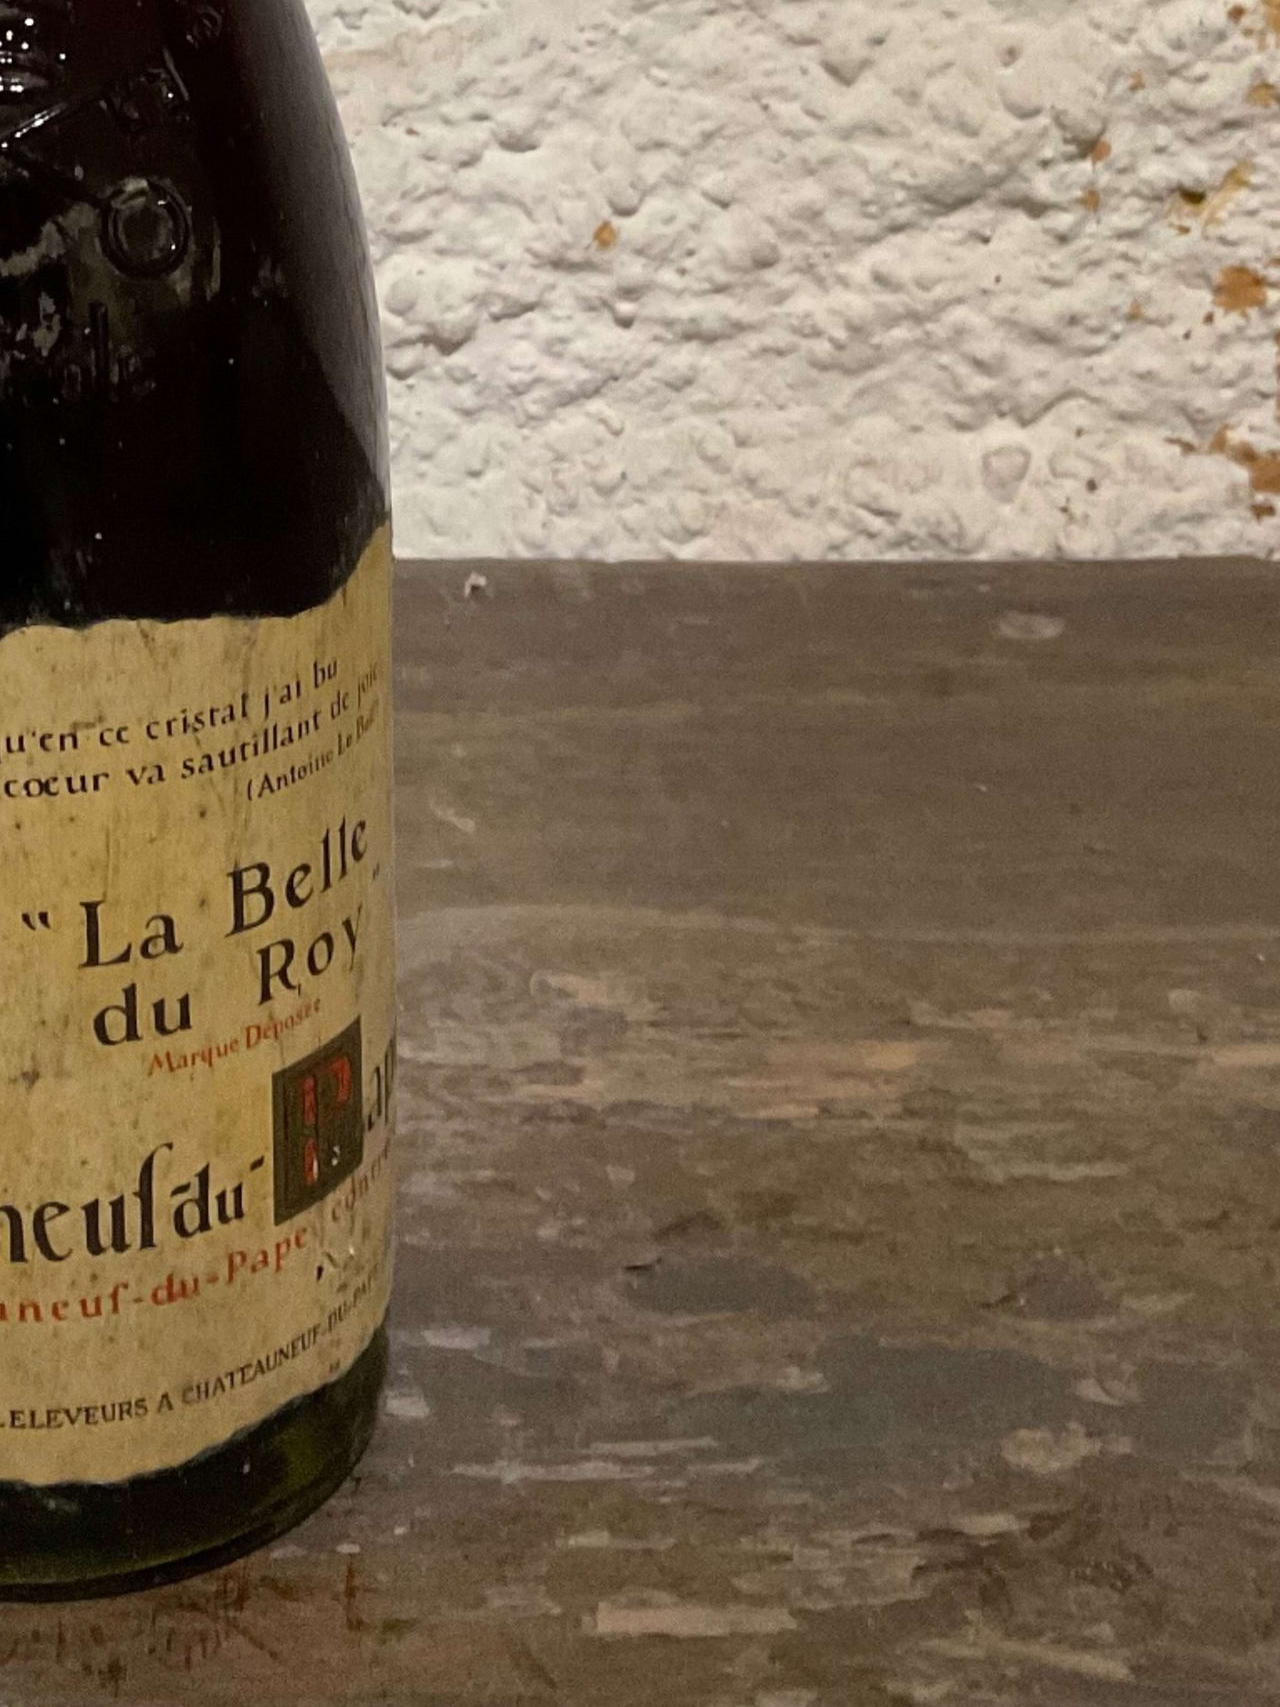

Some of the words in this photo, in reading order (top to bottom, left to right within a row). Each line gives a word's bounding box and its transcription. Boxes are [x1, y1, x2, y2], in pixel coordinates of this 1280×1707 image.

[99, 725, 130, 747] ce
[146, 692, 249, 740] cristal
[126, 763, 166, 786] va
[181, 707, 322, 780] sautillant
[225, 815, 368, 938] Belle
[93, 982, 193, 1047] du
[147, 1037, 239, 1079] Marque
